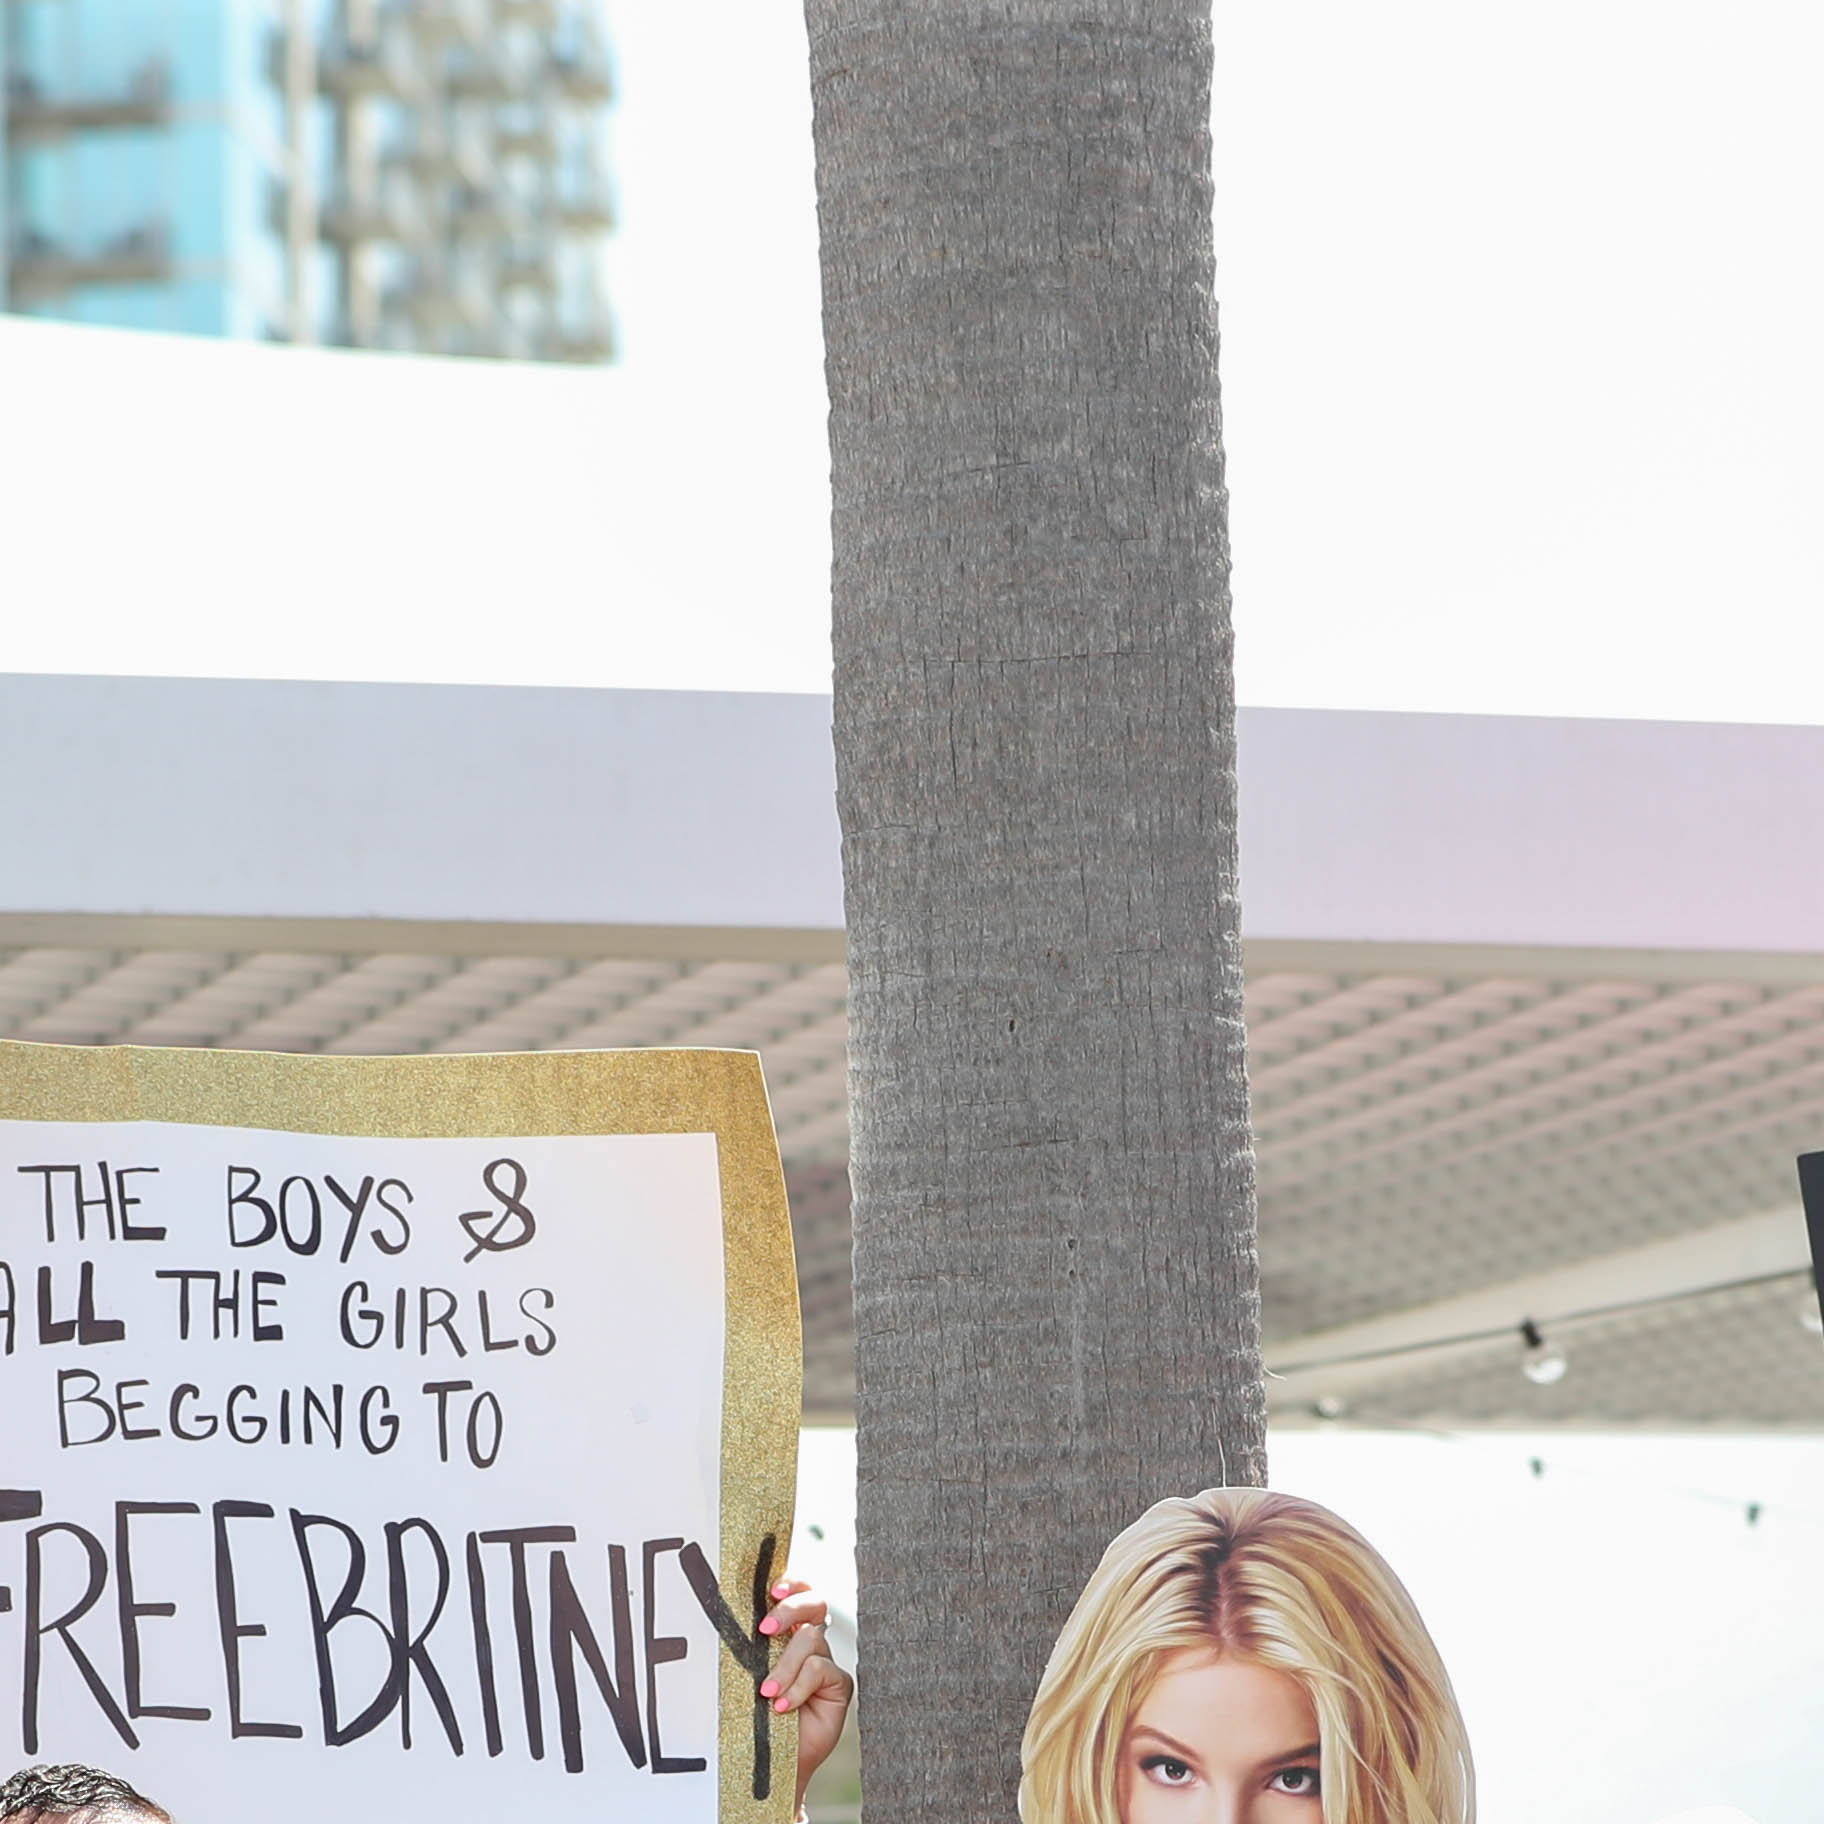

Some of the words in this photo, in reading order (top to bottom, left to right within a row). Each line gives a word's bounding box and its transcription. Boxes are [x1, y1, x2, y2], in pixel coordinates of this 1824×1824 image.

[17, 1161, 167, 1242] THE
[227, 1166, 413, 1263] BOYS
[156, 1270, 283, 1342] THE
[341, 1281, 557, 1357] GIRLS
[58, 1369, 400, 1450] BEGGING
[424, 1382, 503, 1468] TO
